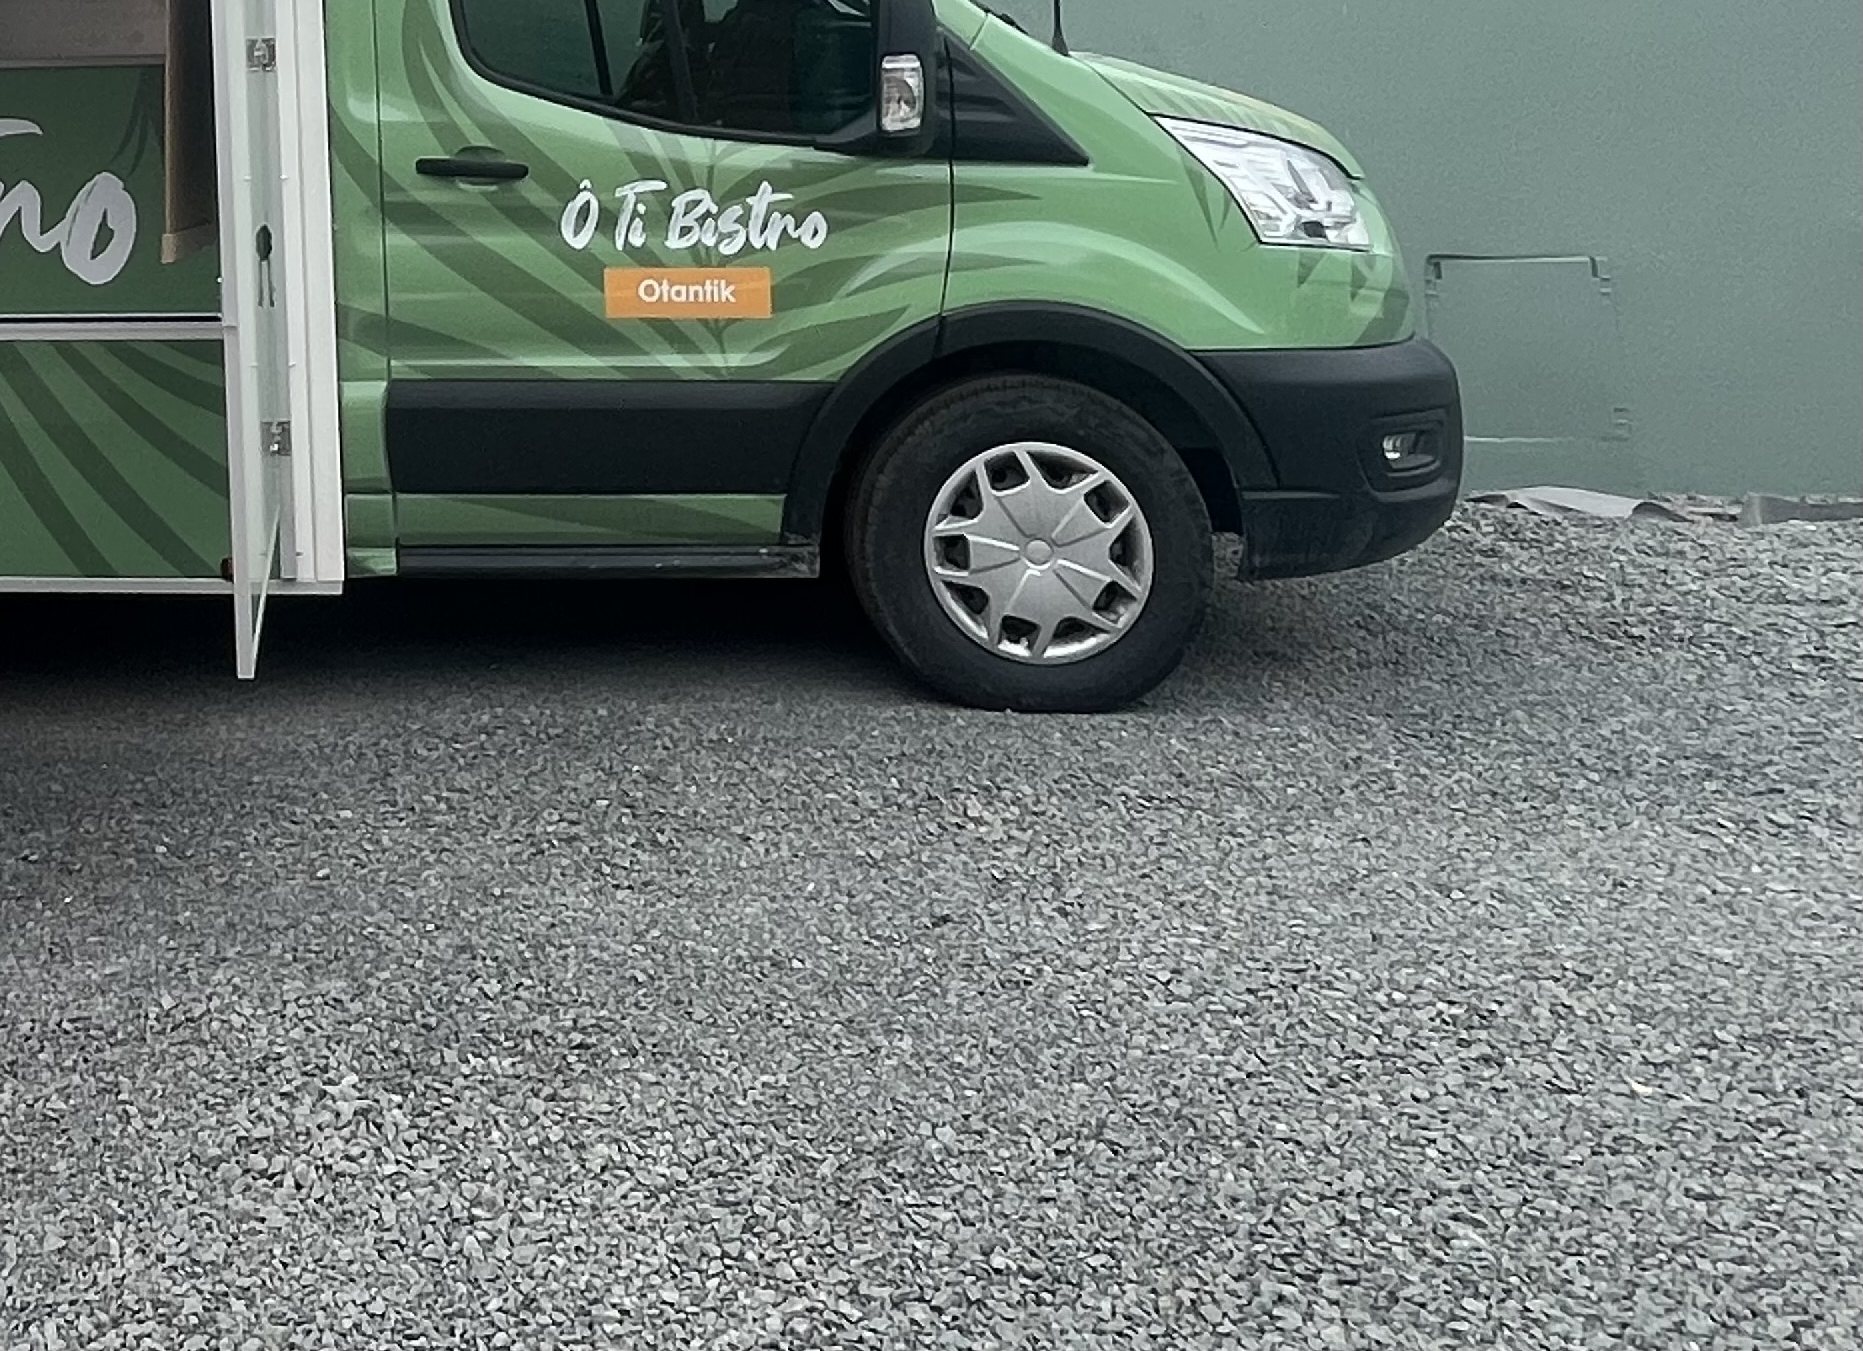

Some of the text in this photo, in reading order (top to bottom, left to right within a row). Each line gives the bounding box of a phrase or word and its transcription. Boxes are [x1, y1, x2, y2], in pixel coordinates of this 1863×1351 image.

[560, 179, 829, 255] Ô Ti Bistro
[638, 279, 737, 303] Otantik
